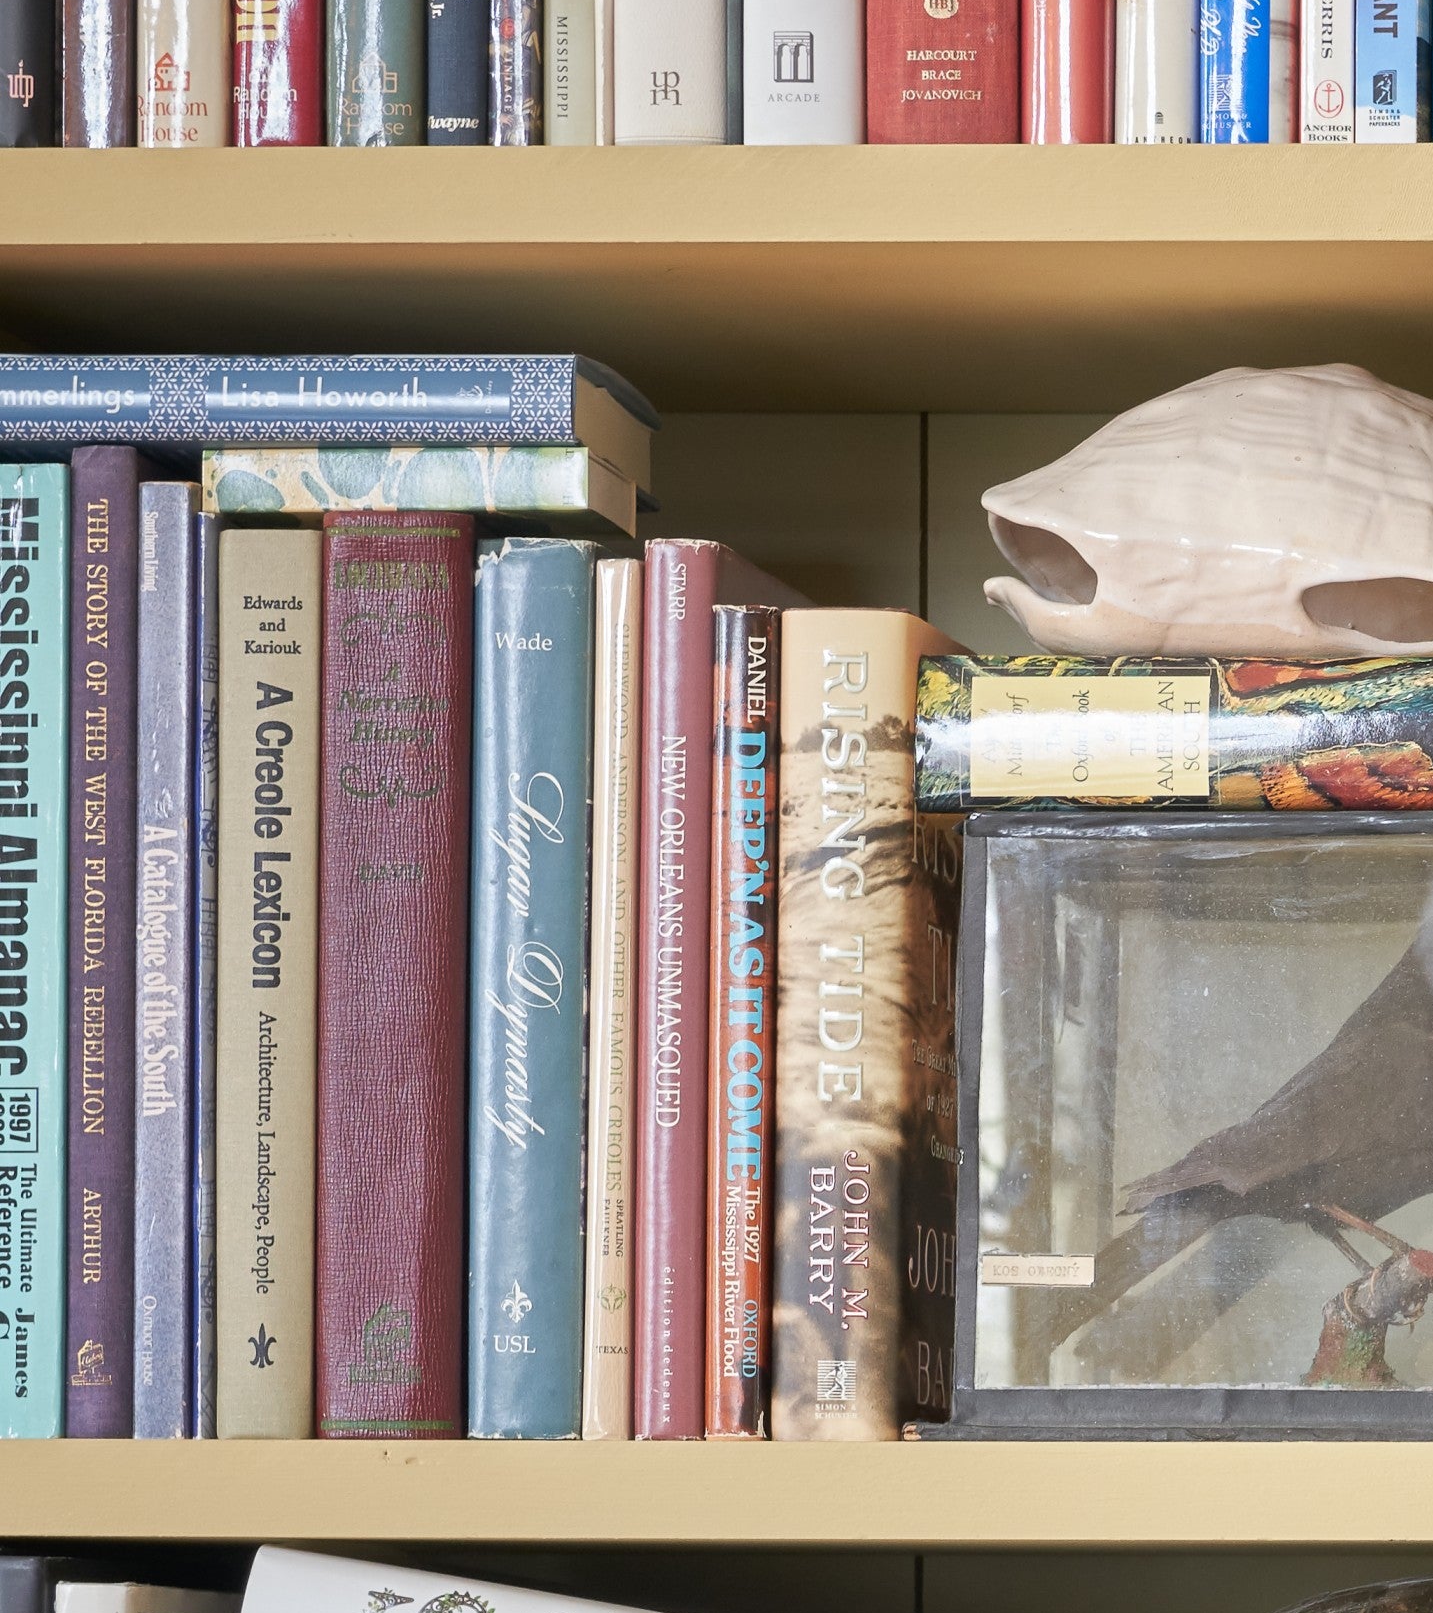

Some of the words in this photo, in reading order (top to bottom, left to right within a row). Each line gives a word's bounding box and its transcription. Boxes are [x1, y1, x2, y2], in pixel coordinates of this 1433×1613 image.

[907, 50, 976, 62] HARCOURT
[921, 70, 961, 81] BRACE
[901, 90, 981, 102] JOVANOVICH
[244, 596, 303, 611] Edwards
[259, 621, 286, 632] and
[244, 640, 301, 656] Kariouk
[495, 633, 552, 652] Wade
[494, 1336, 535, 1353] USL
